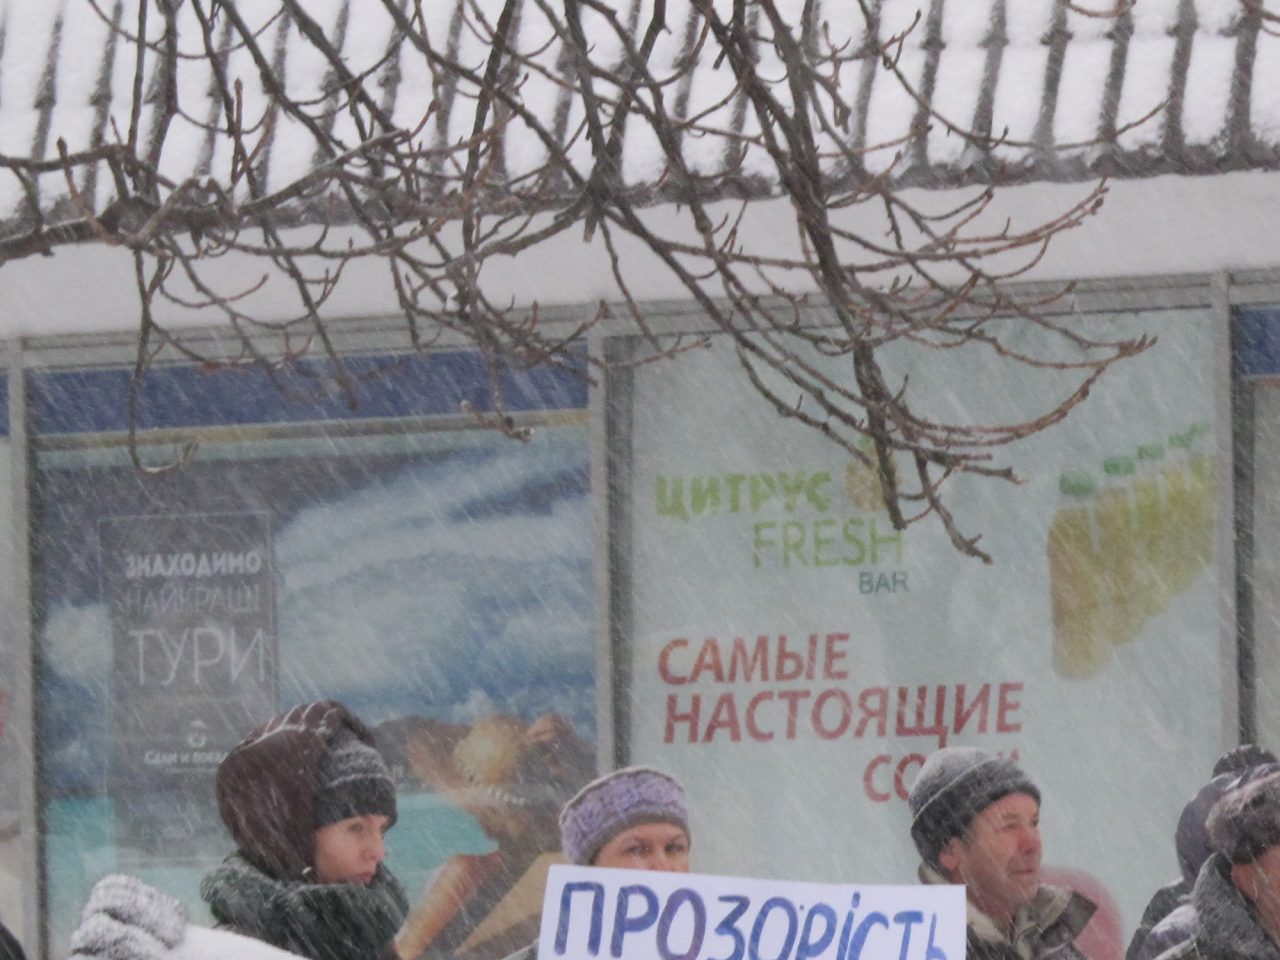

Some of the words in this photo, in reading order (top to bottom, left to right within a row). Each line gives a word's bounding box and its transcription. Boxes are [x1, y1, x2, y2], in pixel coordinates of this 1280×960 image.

[654, 471, 832, 521] ЦИТРУС
[125, 552, 261, 578] ЗНАХОДИМО
[752, 517, 902, 568] FRESH
[859, 570, 909, 594] BAR
[128, 626, 265, 686] ТУРИ
[658, 633, 850, 685] САМЫЕ
[663, 682, 1024, 748] НАСТОЯЩИЕ
